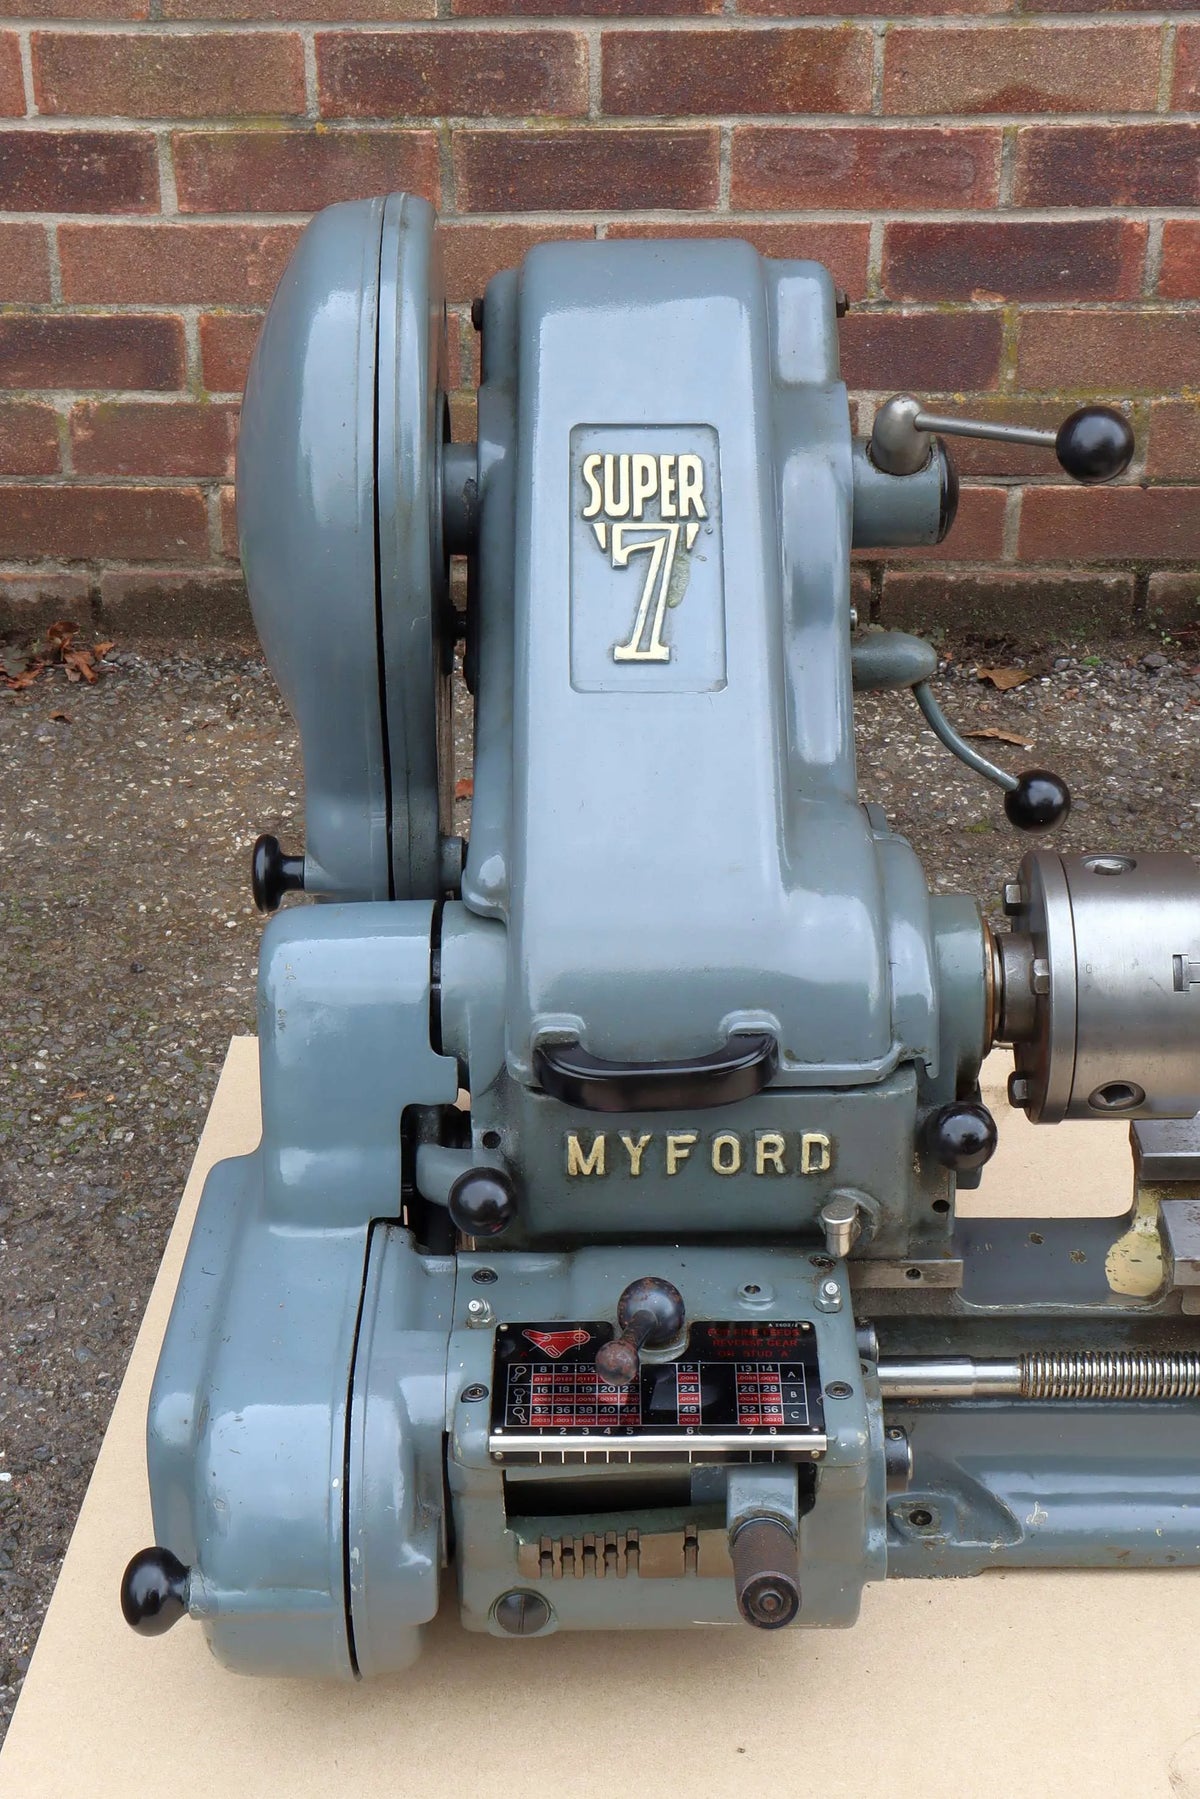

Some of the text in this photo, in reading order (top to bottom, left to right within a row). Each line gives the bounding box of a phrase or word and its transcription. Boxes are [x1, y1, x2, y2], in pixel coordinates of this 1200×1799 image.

[583, 454, 707, 518] SUPER
[567, 1131, 831, 1175] MYFORD
[713, 1338, 797, 1347] REVERSE GEAR
[743, 1350, 773, 1358] STUD
[561, 1365, 569, 1373] 9
[600, 1385, 616, 1393] 20
[621, 1385, 636, 1393] 22
[680, 1385, 695, 1393] 24
[740, 1385, 755, 1393] 26
[763, 1385, 777, 1393] 28
[534, 1406, 549, 1414] 32
[555, 1406, 570, 1414] 36
[578, 1406, 593, 1414] 38
[600, 1406, 615, 1414] 40
[790, 1411, 800, 1419] C
[686, 1427, 694, 1435] 6
[747, 1427, 754, 1435] 7
[769, 1427, 777, 1435] 8
